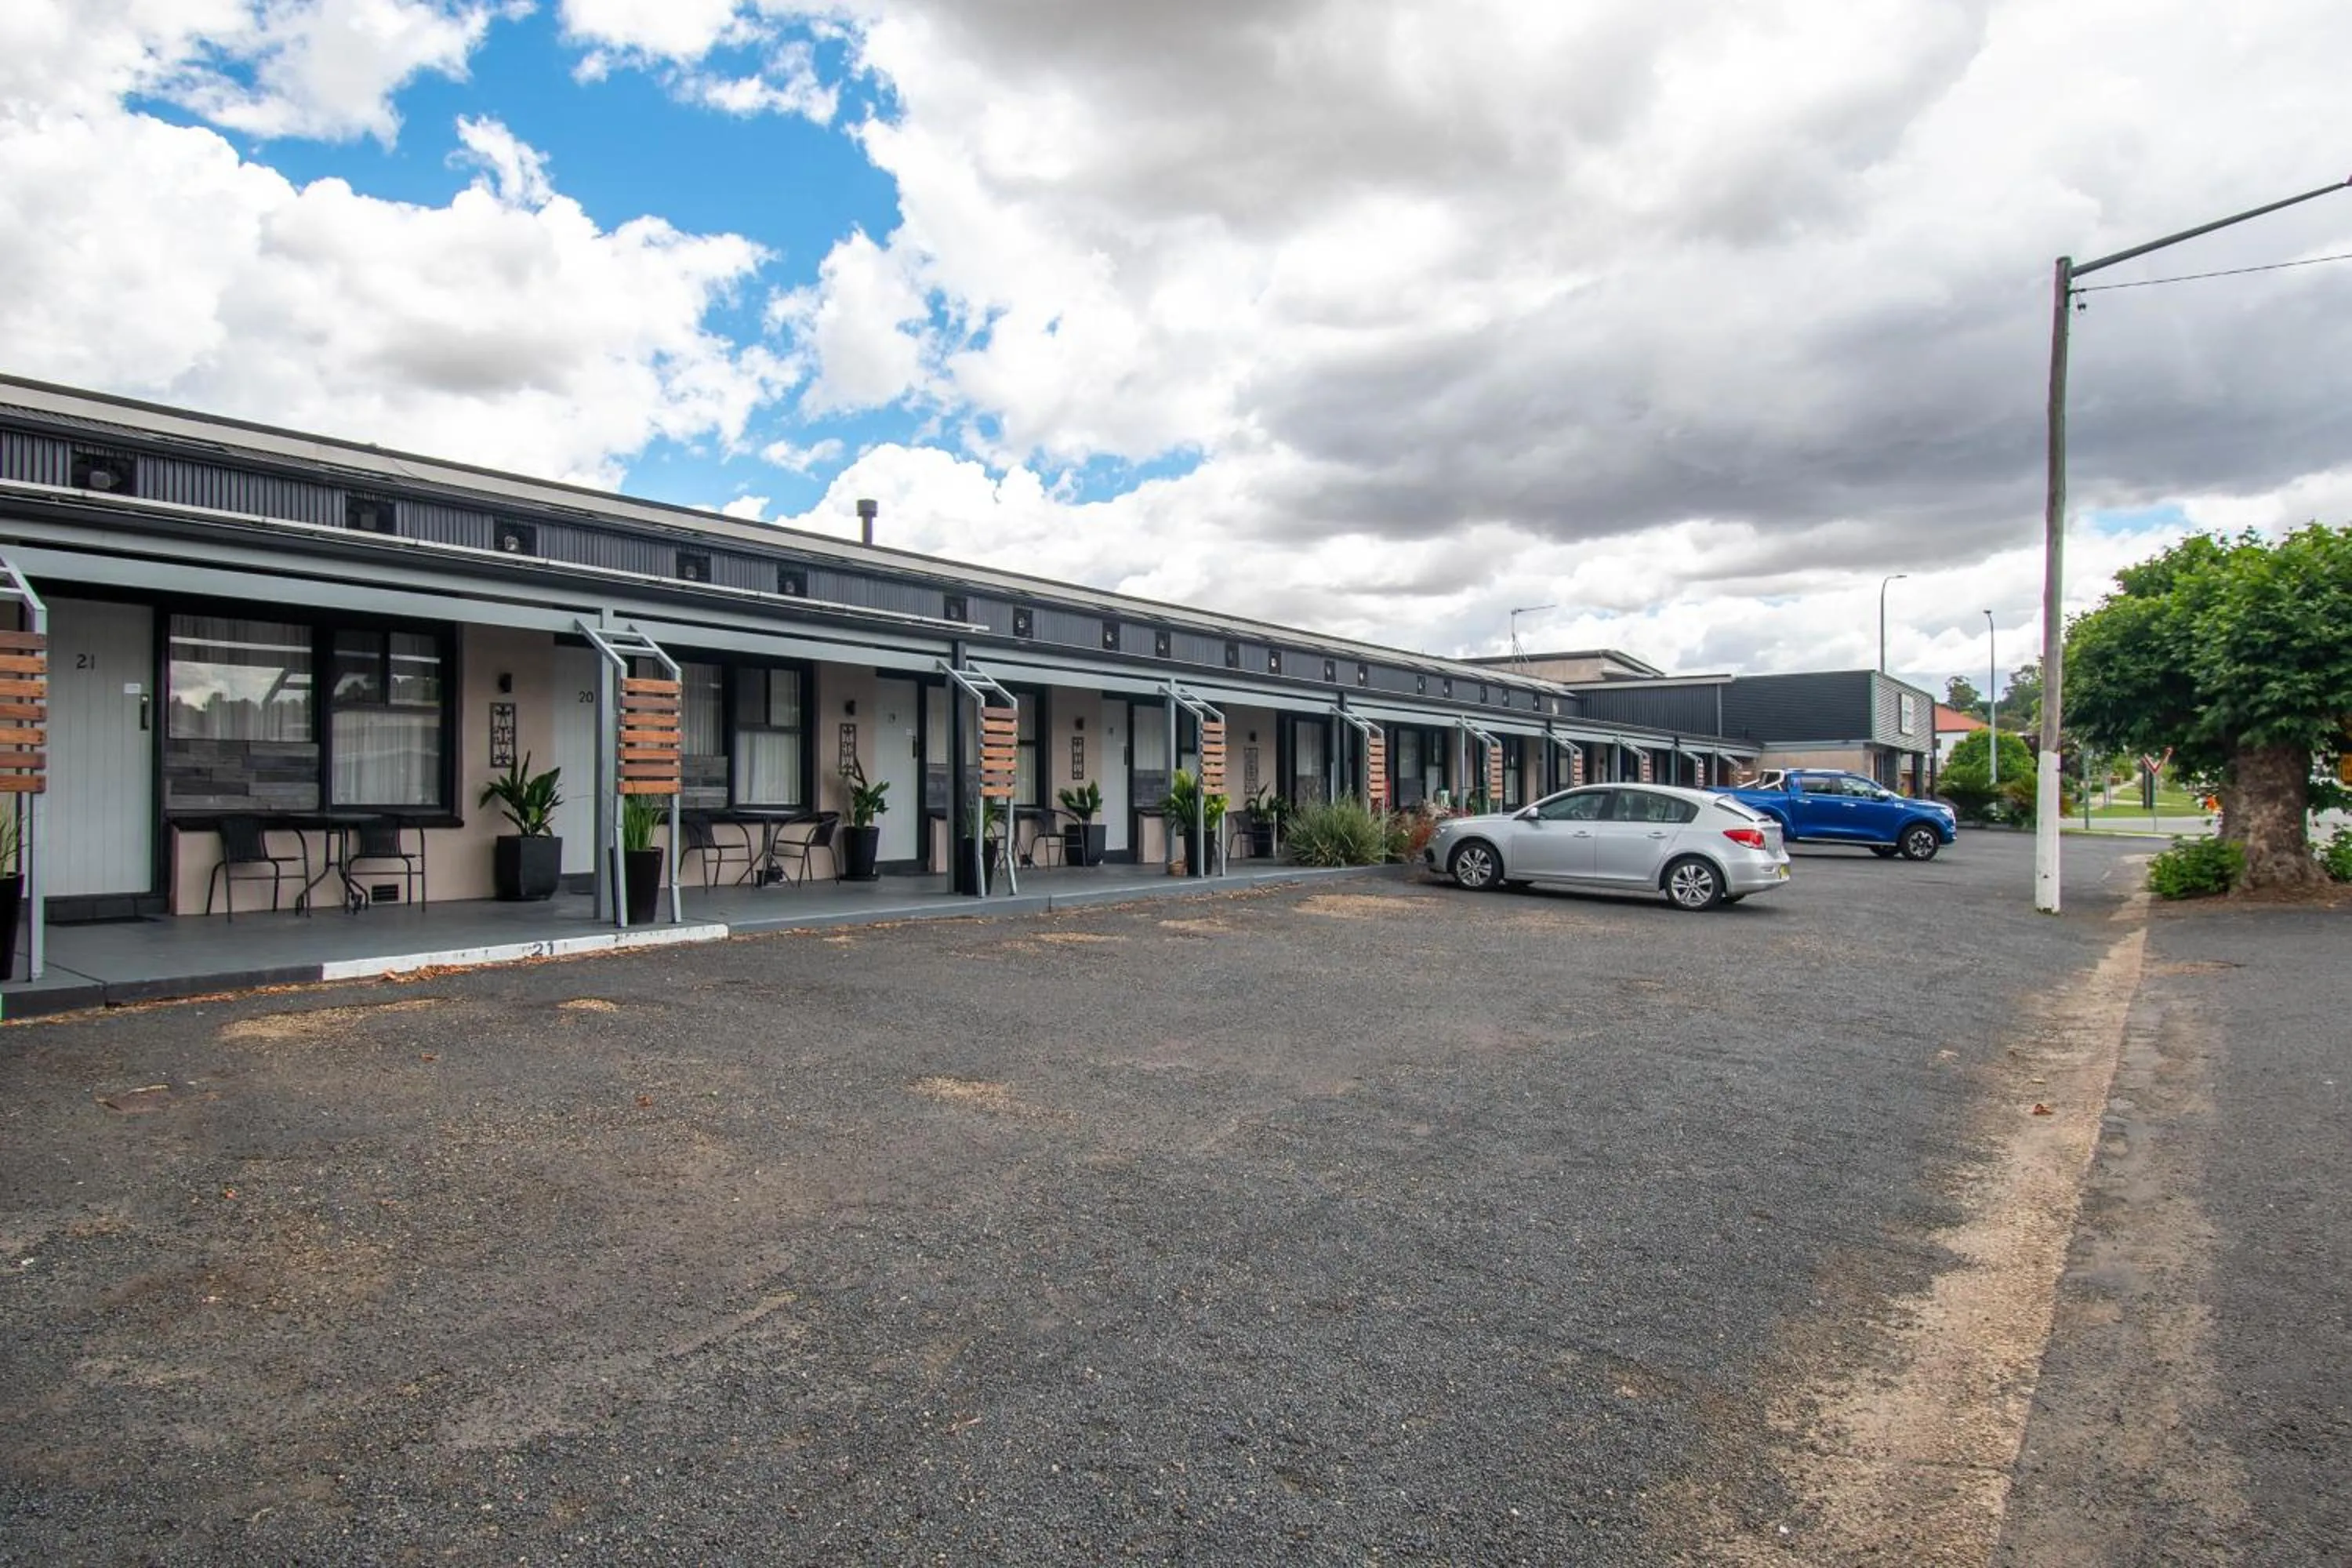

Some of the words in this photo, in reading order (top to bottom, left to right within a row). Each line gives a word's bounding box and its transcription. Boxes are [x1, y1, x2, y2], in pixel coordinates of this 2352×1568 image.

[76, 653, 95, 670] 21
[579, 690, 593, 703] 20
[532, 941, 554, 956] 21
